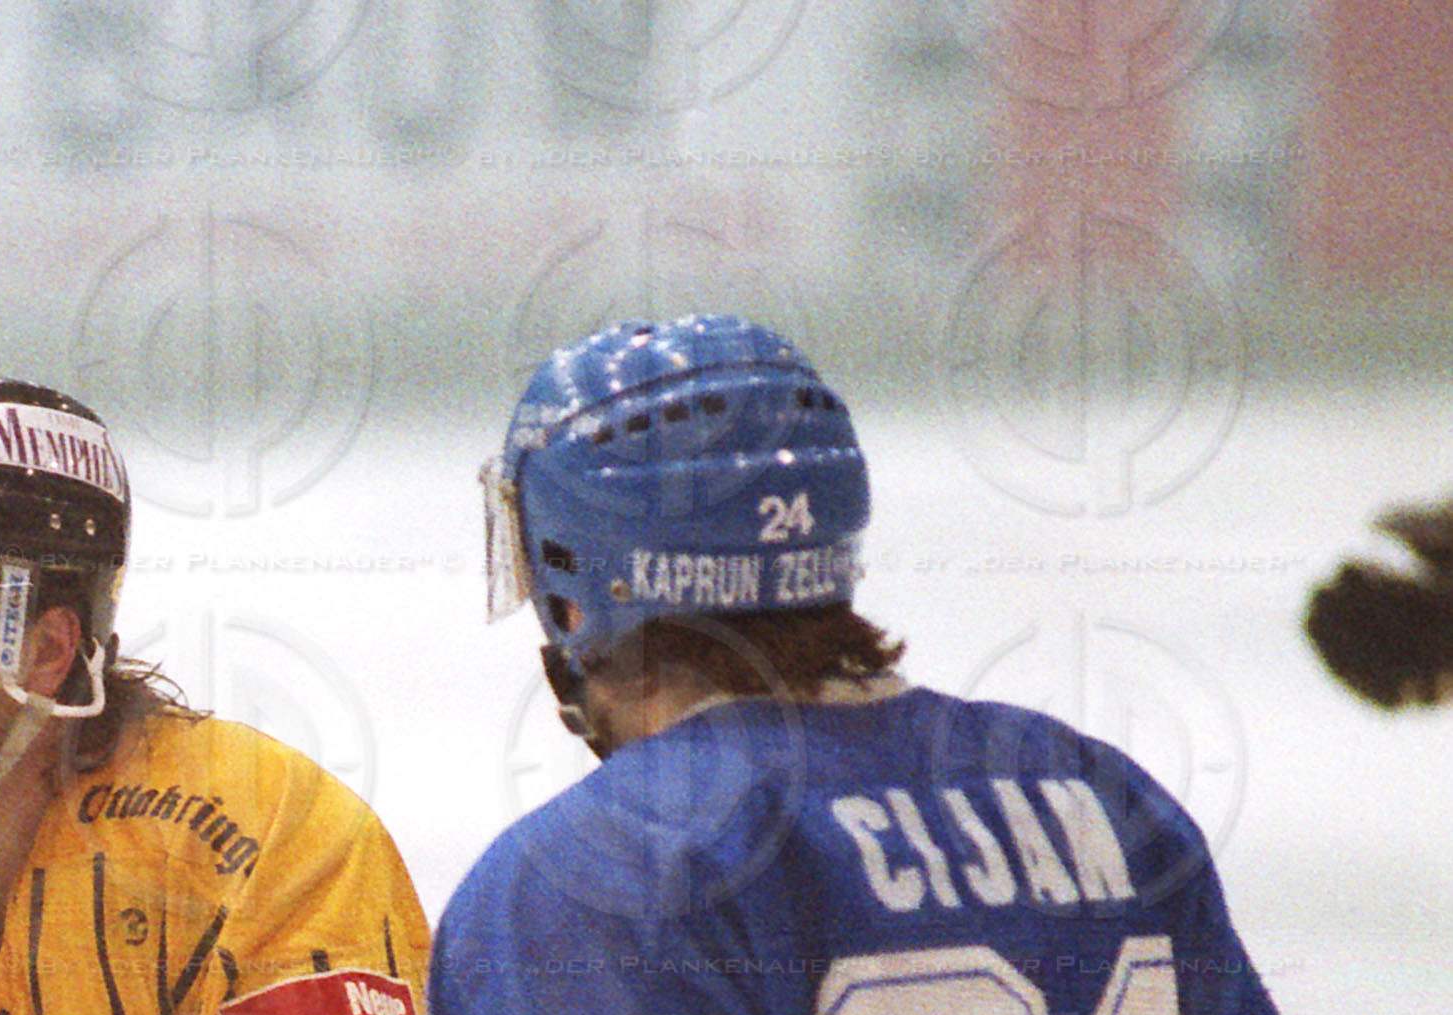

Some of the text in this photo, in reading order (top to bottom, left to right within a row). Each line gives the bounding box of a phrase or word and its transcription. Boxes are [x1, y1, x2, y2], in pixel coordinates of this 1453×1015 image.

[757, 491, 815, 543] 24
[630, 548, 761, 605] KAPRUN
[830, 777, 1136, 913] CIJAN
